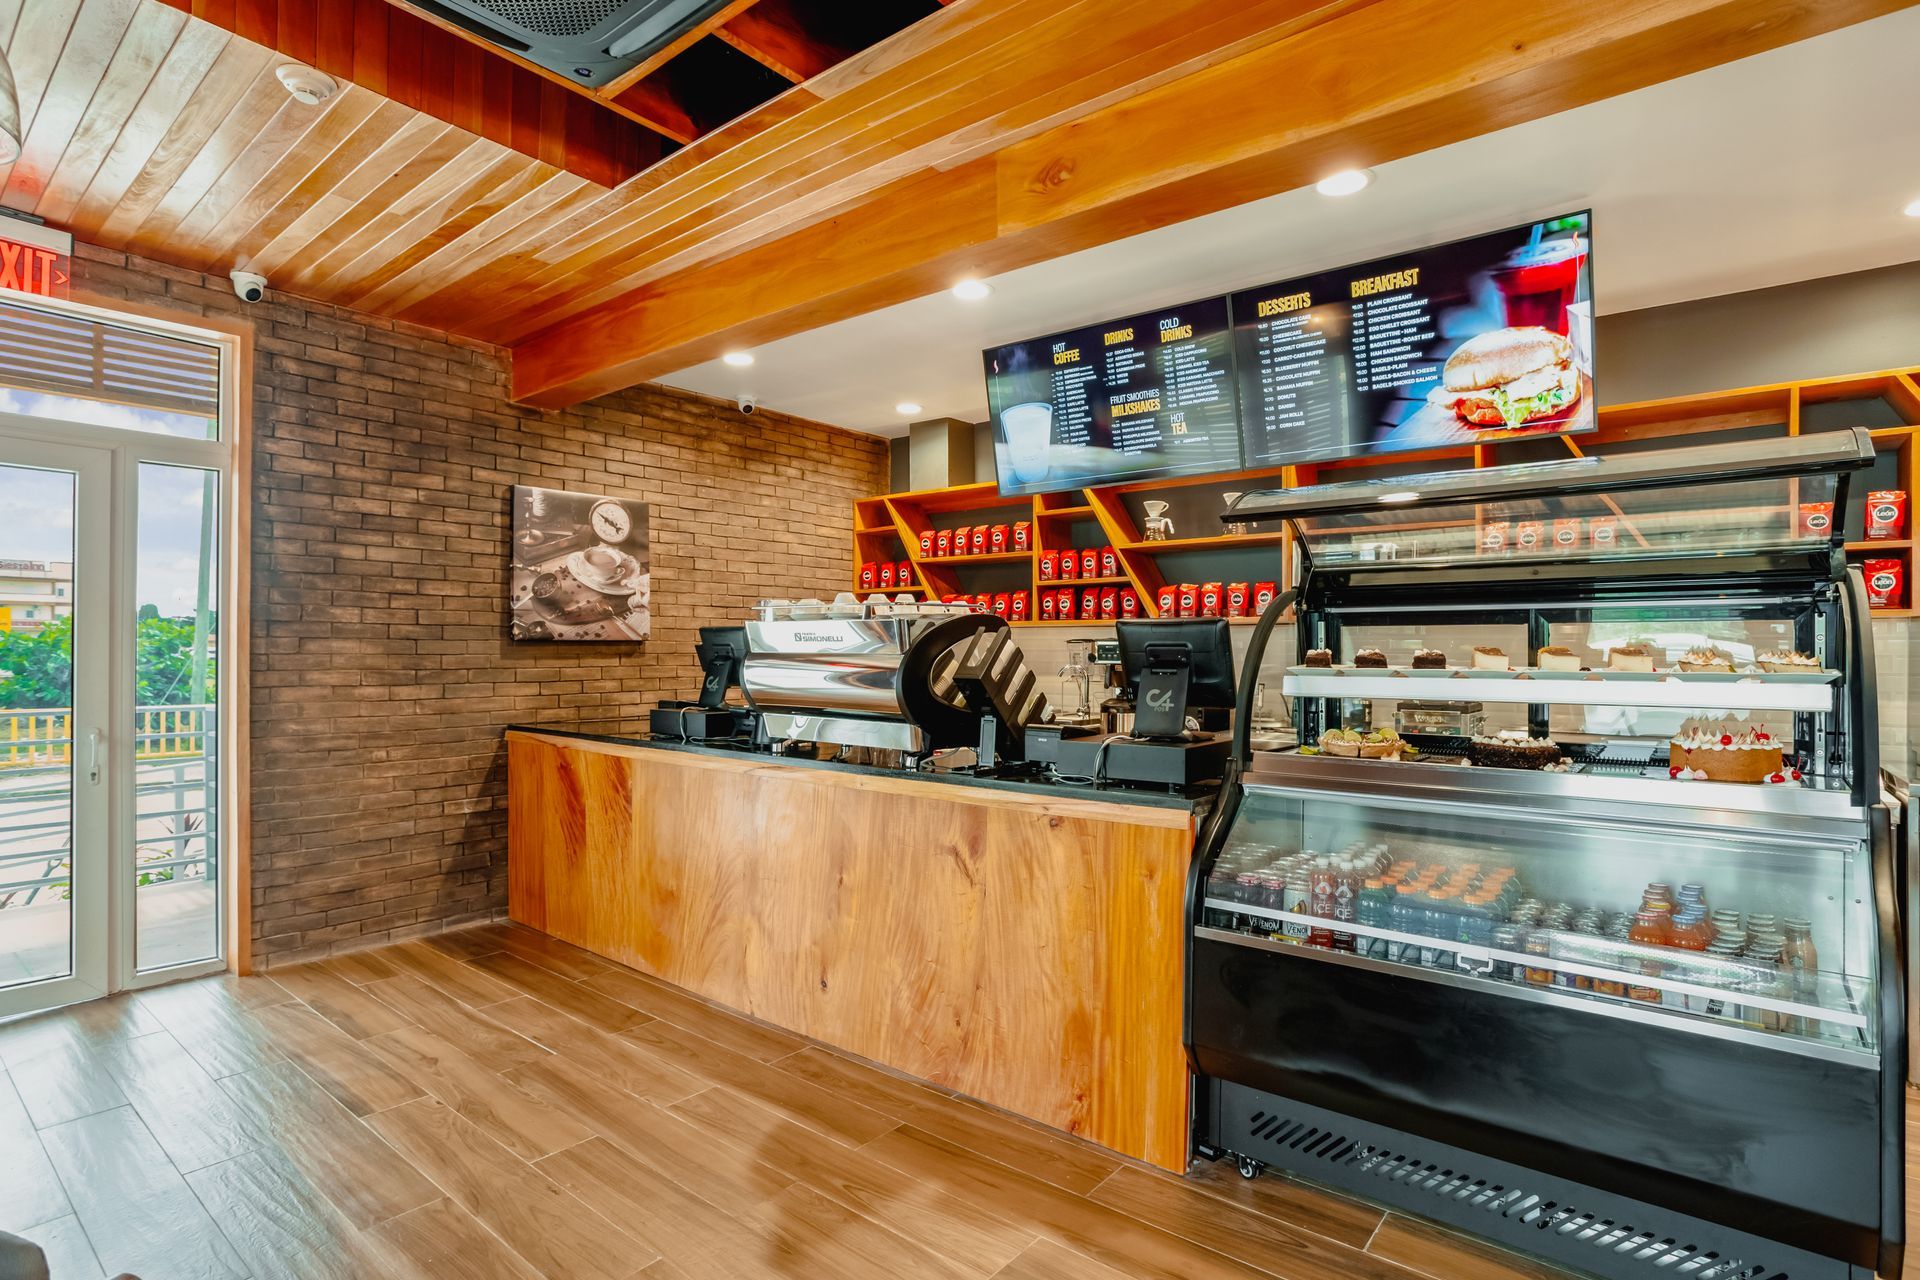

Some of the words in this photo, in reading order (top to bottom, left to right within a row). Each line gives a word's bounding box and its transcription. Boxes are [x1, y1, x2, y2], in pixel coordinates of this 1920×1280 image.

[1351, 268, 1419, 298] BREAKFAST
[1257, 292, 1311, 318] DESSERTS
[1367, 299, 1383, 308] PLAIN
[1383, 293, 1413, 304] CROISSANT
[1368, 305, 1398, 316] CHOCOLATE
[1398, 299, 1429, 310] CROISSANT
[1271, 317, 1299, 327] CHOCOLATE
[1368, 315, 1391, 324] CHICKEN
[1391, 309, 1421, 319] CROISSANT
[1380, 321, 1400, 330] OMELET
[1400, 316, 1431, 326] CROISSANT
[1160, 317, 1179, 330] COLD
[1104, 328, 1134, 346] DRINKS
[1160, 324, 1192, 343] DRINKS
[1272, 330, 1302, 340] CHEESECAKE
[1422, 332, 1435, 340] BEEF
[1053, 343, 1066, 353] HOT
[1273, 344, 1296, 353] COCONUT
[1295, 339, 1326, 349] CHEESECAKE
[1383, 345, 1411, 355] SANDWICH
[1054, 348, 1080, 366] COFFEE
[1306, 349, 1324, 358] MUFFIN
[1371, 357, 1394, 366] CHICKEN
[1394, 352, 1422, 361] SANDWICH
[1275, 362, 1301, 372] BLUEBERRY
[1301, 359, 1320, 368] MUFFIN
[1416, 366, 1437, 374] CHEESE
[1275, 372, 1302, 382] CHOCOLATE
[1302, 369, 1321, 378] MUFFIN
[1416, 375, 1438, 383] SALMON
[1276, 383, 1296, 391] BANANA
[1110, 394, 1126, 405] FRUIT
[1126, 388, 1160, 402] SMOOTHIES
[1277, 393, 1296, 401] DONUTS
[1111, 398, 1161, 418] MILKSHAKES
[1170, 412, 1185, 423] HOT
[1171, 422, 1188, 435] TEA
[1876, 507, 1895, 517] León
[1146, 689, 1174, 712] C4
